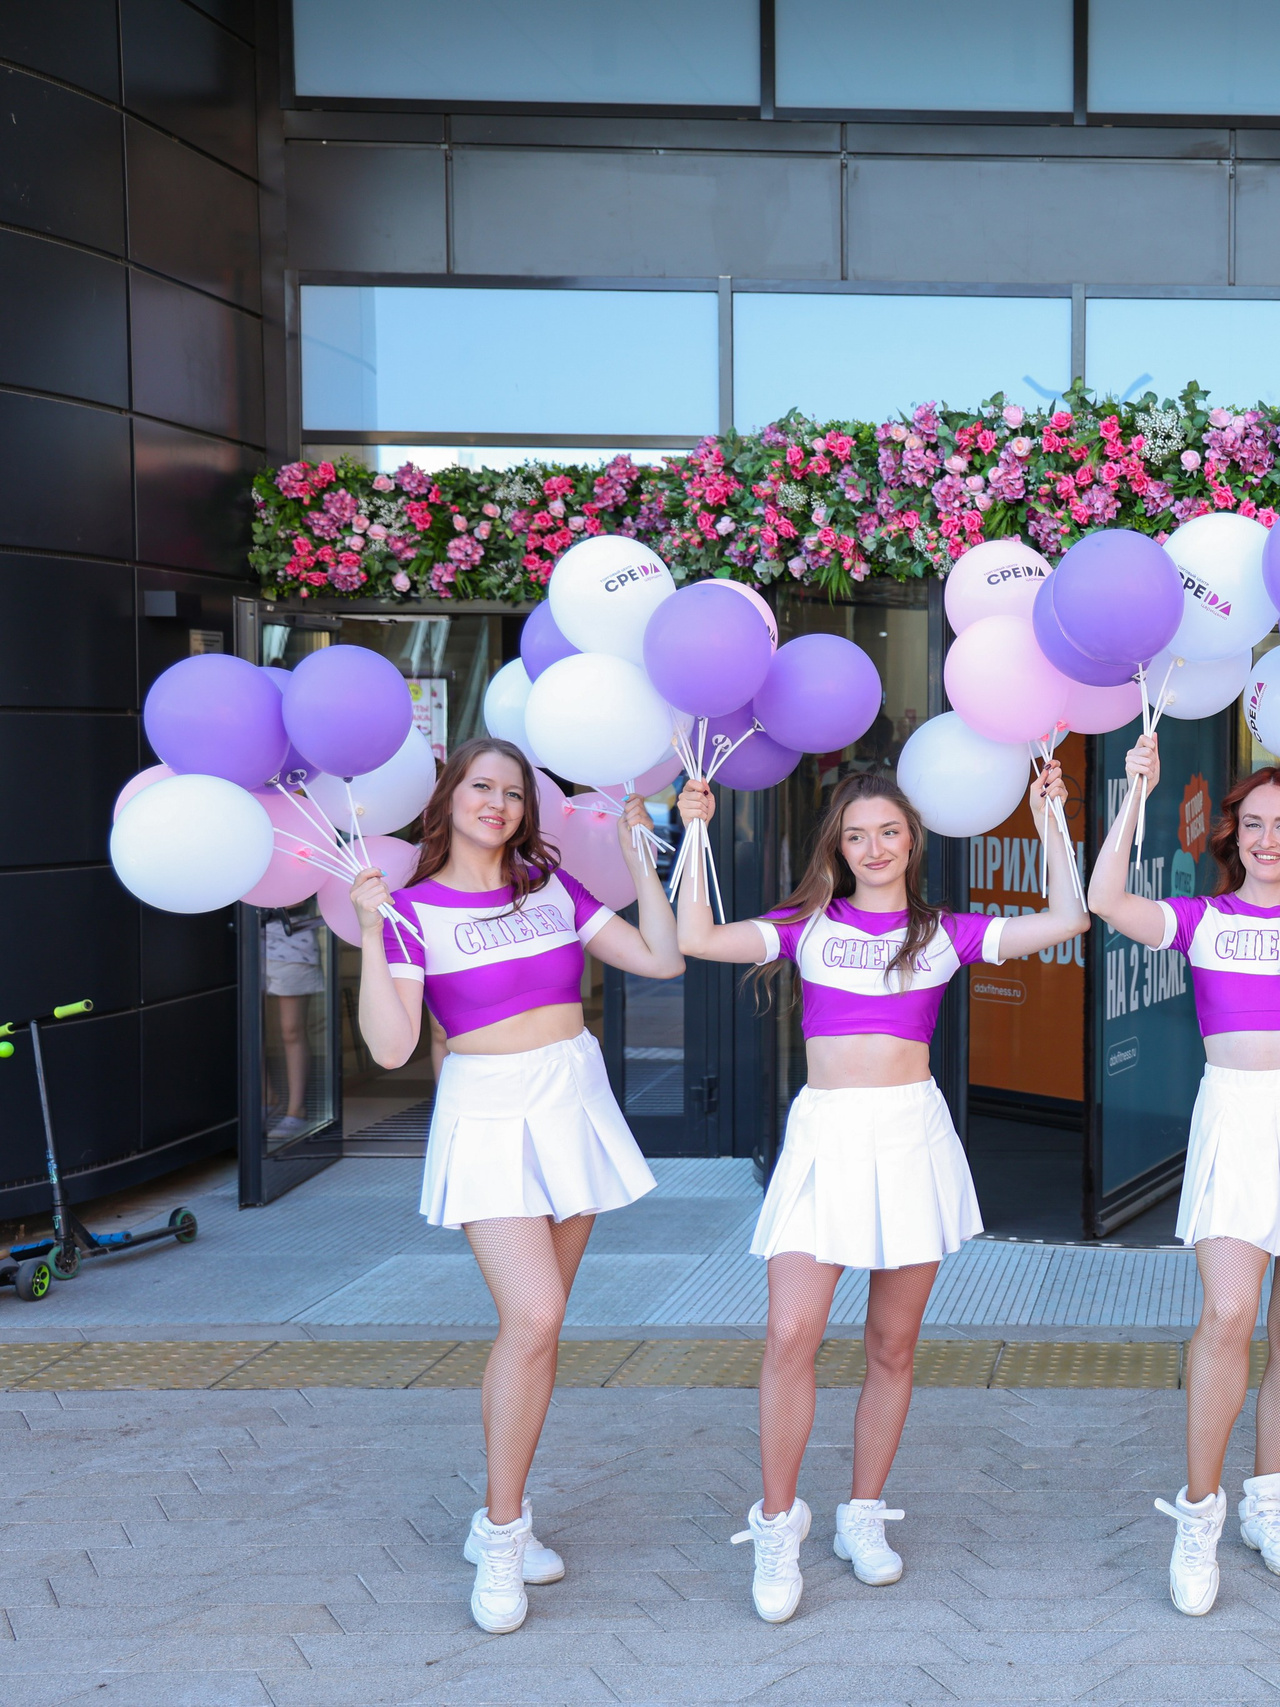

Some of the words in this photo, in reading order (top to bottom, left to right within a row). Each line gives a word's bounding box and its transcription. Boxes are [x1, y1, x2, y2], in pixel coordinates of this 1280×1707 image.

[454, 904, 573, 955] CHEER
[973, 982, 1022, 998] ddxfitness.ru
[1106, 948, 1126, 1021] НА
[1129, 943, 1139, 1012] 2
[1109, 1047, 1137, 1068] ddxfitness.ru
